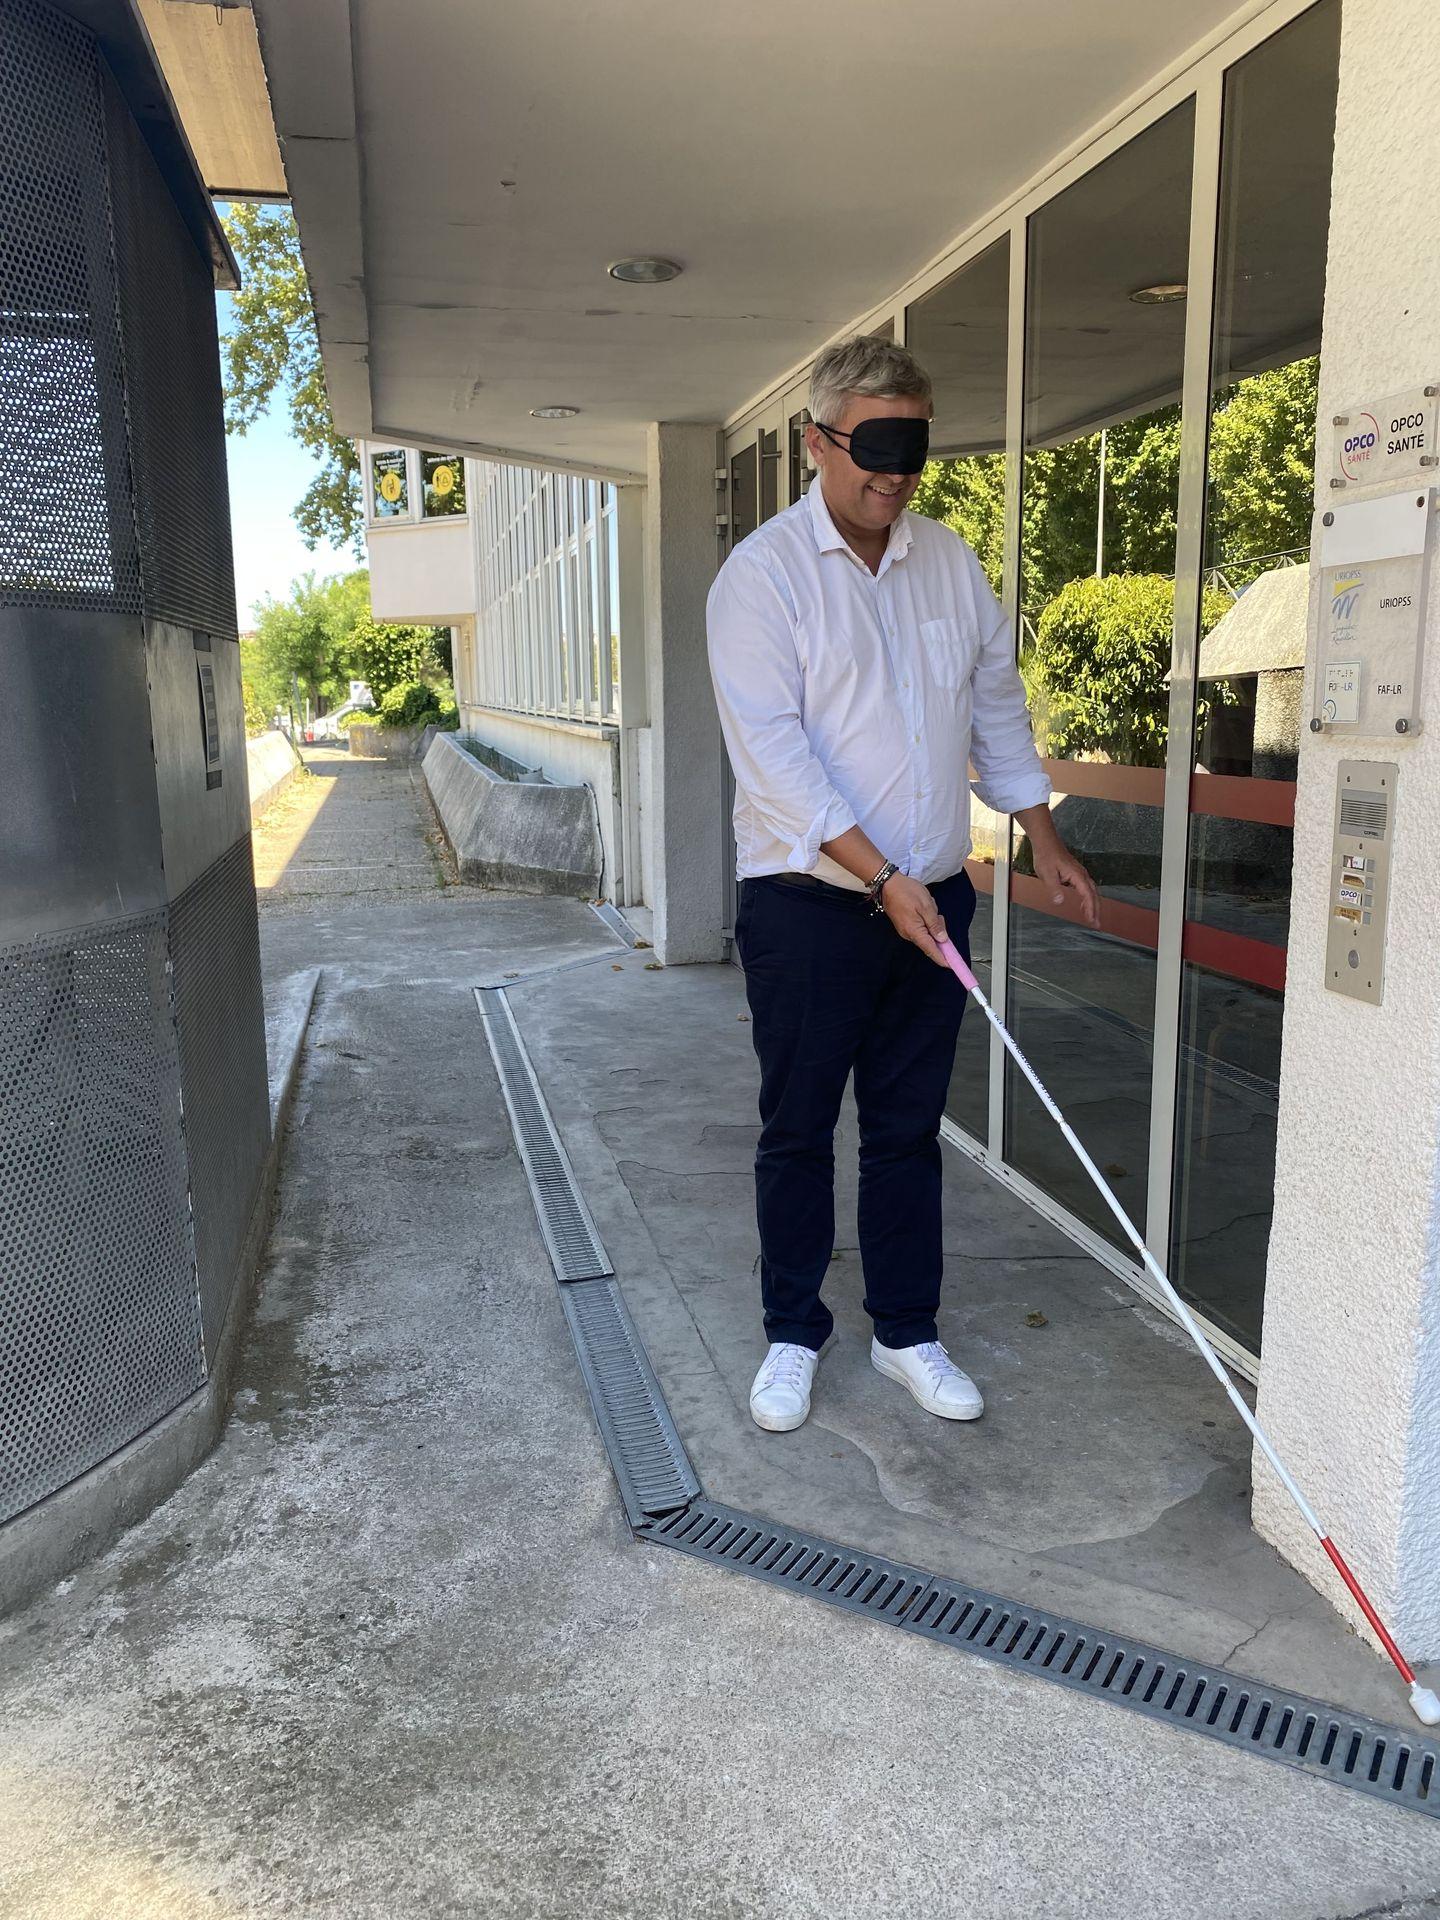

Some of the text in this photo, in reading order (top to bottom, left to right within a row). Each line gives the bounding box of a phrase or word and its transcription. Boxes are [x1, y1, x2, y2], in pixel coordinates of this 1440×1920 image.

[1390, 412, 1424, 433] OPCO
[1344, 433, 1375, 452] OPCO
[1387, 430, 1424, 454] SANTÉ
[1335, 569, 1361, 581] URIOPSS
[1380, 596, 1412, 608] URIOPSS
[1377, 684, 1402, 694] FAF-LR
